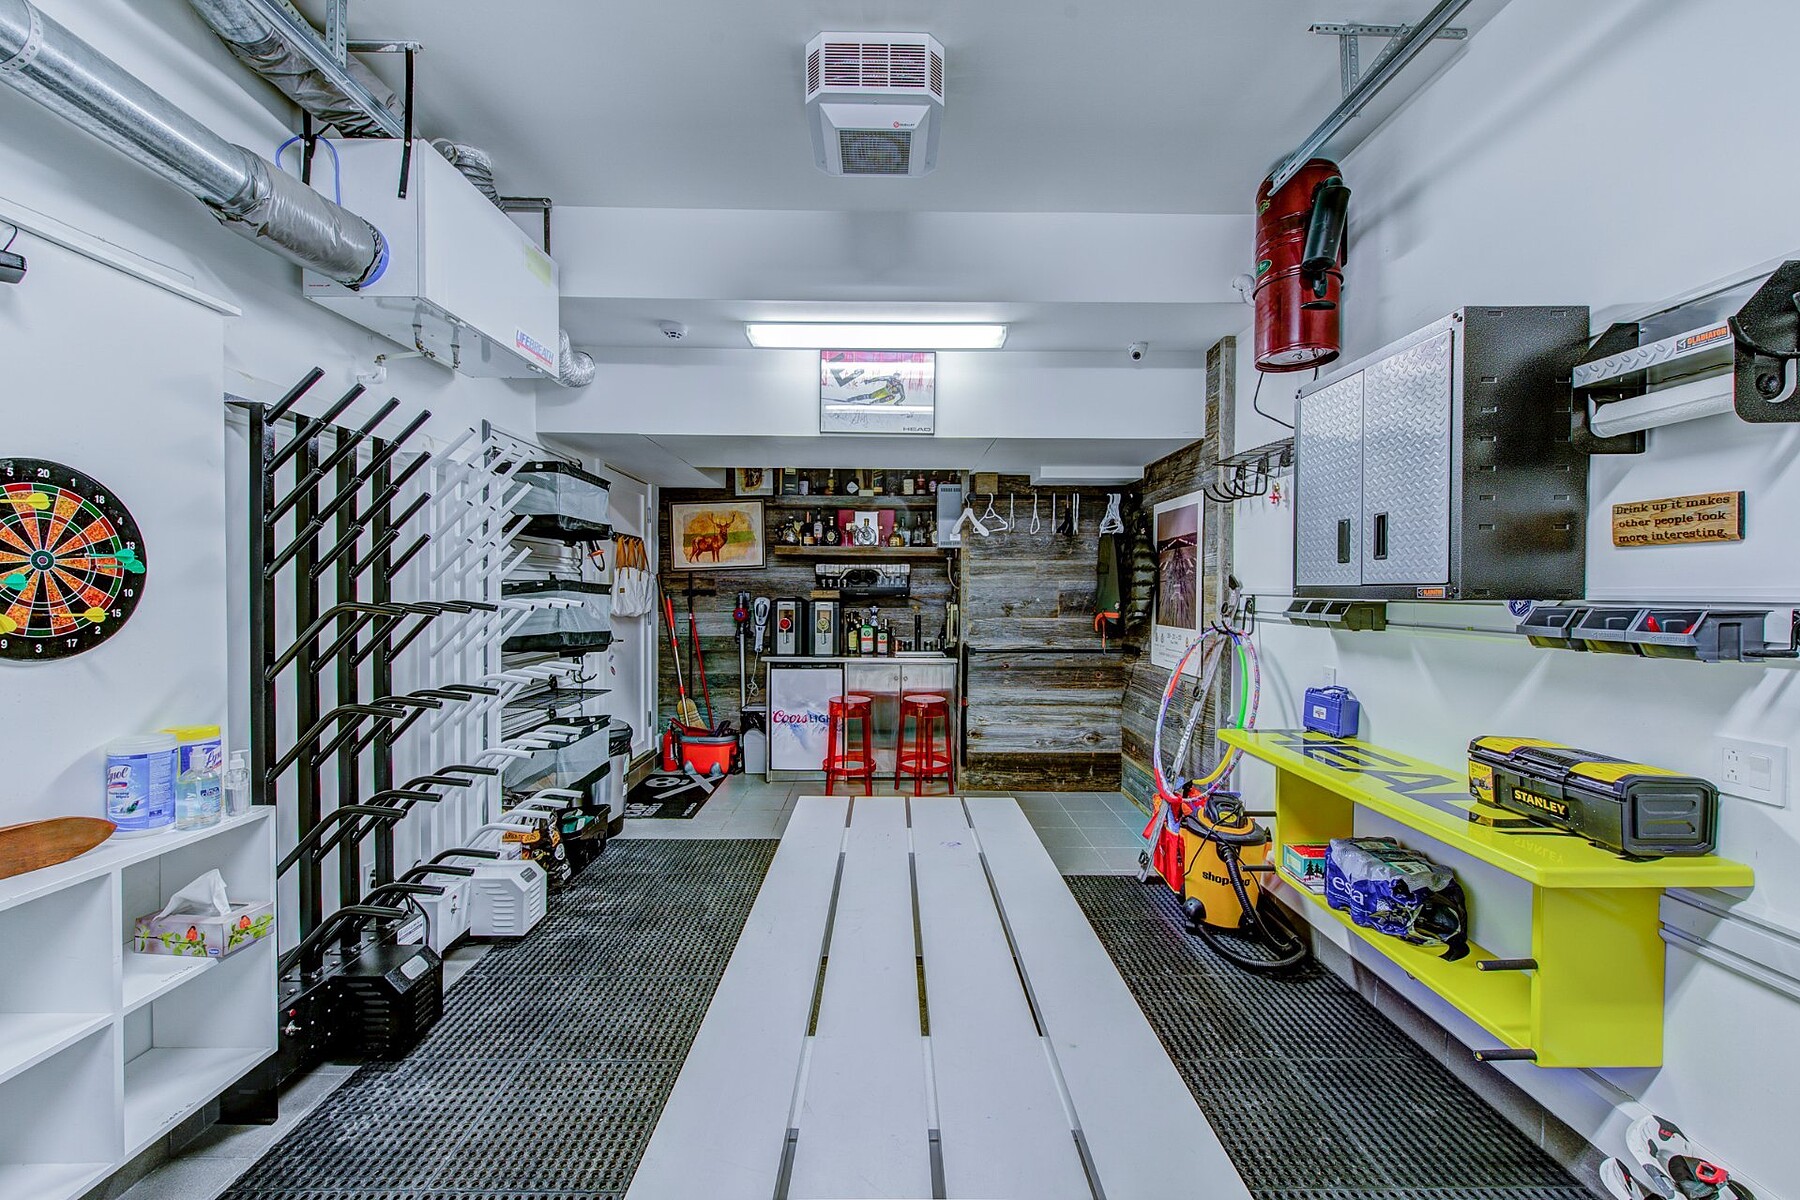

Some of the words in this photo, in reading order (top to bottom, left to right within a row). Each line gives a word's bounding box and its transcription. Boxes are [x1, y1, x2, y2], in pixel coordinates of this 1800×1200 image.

[1687, 327, 1727, 345] GLADIATOR
[516, 330, 554, 362] LIFEBREATH
[7, 467, 13, 476] 5
[37, 468, 50, 478] 20
[71, 478, 76, 487] 1
[94, 495, 105, 504] 18
[1616, 504, 1649, 515] Drink
[1652, 504, 1667, 512] up
[1671, 500, 1682, 509] it
[1686, 496, 1730, 507] makes
[117, 517, 123, 525] 4
[1618, 519, 1650, 528] other
[1654, 514, 1694, 527] people
[1697, 511, 1727, 521] look
[1618, 533, 1648, 543] more
[1651, 528, 1728, 540] interesting.
[126, 541, 135, 550] 13
[123, 589, 134, 597] 10
[111, 609, 121, 617] 15
[94, 626, 101, 634] 2
[66, 639, 78, 648] 17
[35, 644, 42, 653] 3
[773, 710, 807, 723] Coors
[809, 714, 832, 723] LIGH
[1514, 789, 1566, 815] STANLEY
[1333, 877, 1364, 905] esa
